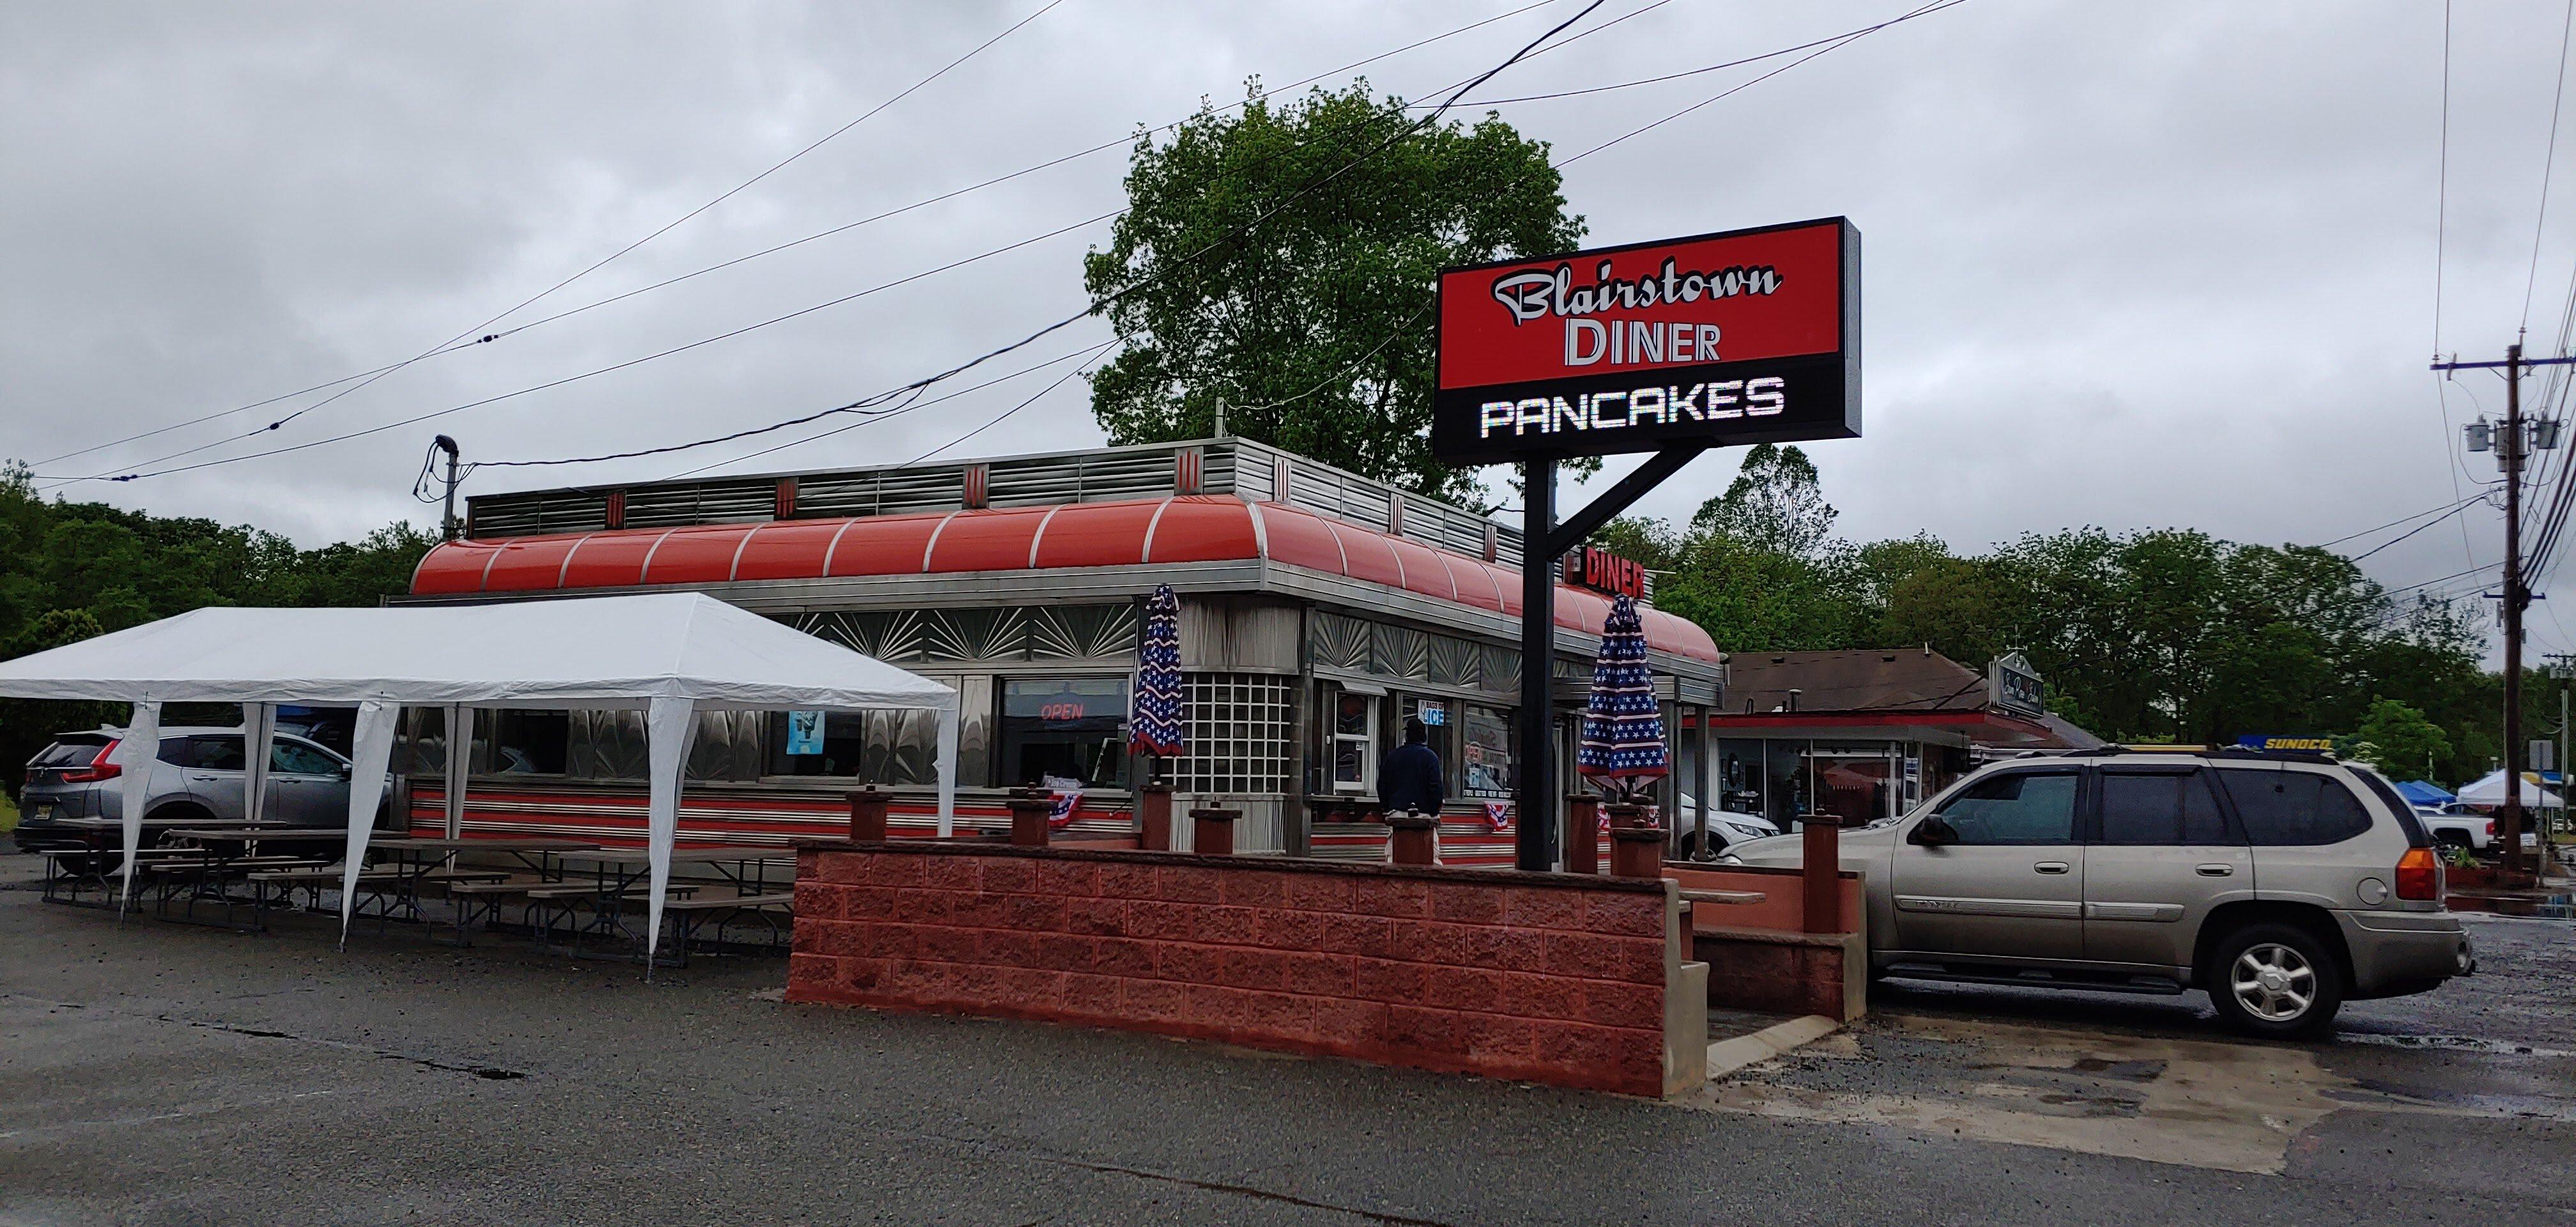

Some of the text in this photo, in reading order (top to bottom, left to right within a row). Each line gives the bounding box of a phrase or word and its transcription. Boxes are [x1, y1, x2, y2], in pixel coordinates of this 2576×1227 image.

[1494, 259, 1782, 325] Blairstown
[1565, 318, 1722, 366] DINER
[1480, 376, 1786, 438] PANCAKES
[1586, 546, 1644, 599] DINER
[1041, 703, 1084, 720] OPEN
[1426, 701, 1438, 709] BAGS
[1427, 709, 1445, 725] ICE
[2264, 738, 2332, 750] SUNOCO
